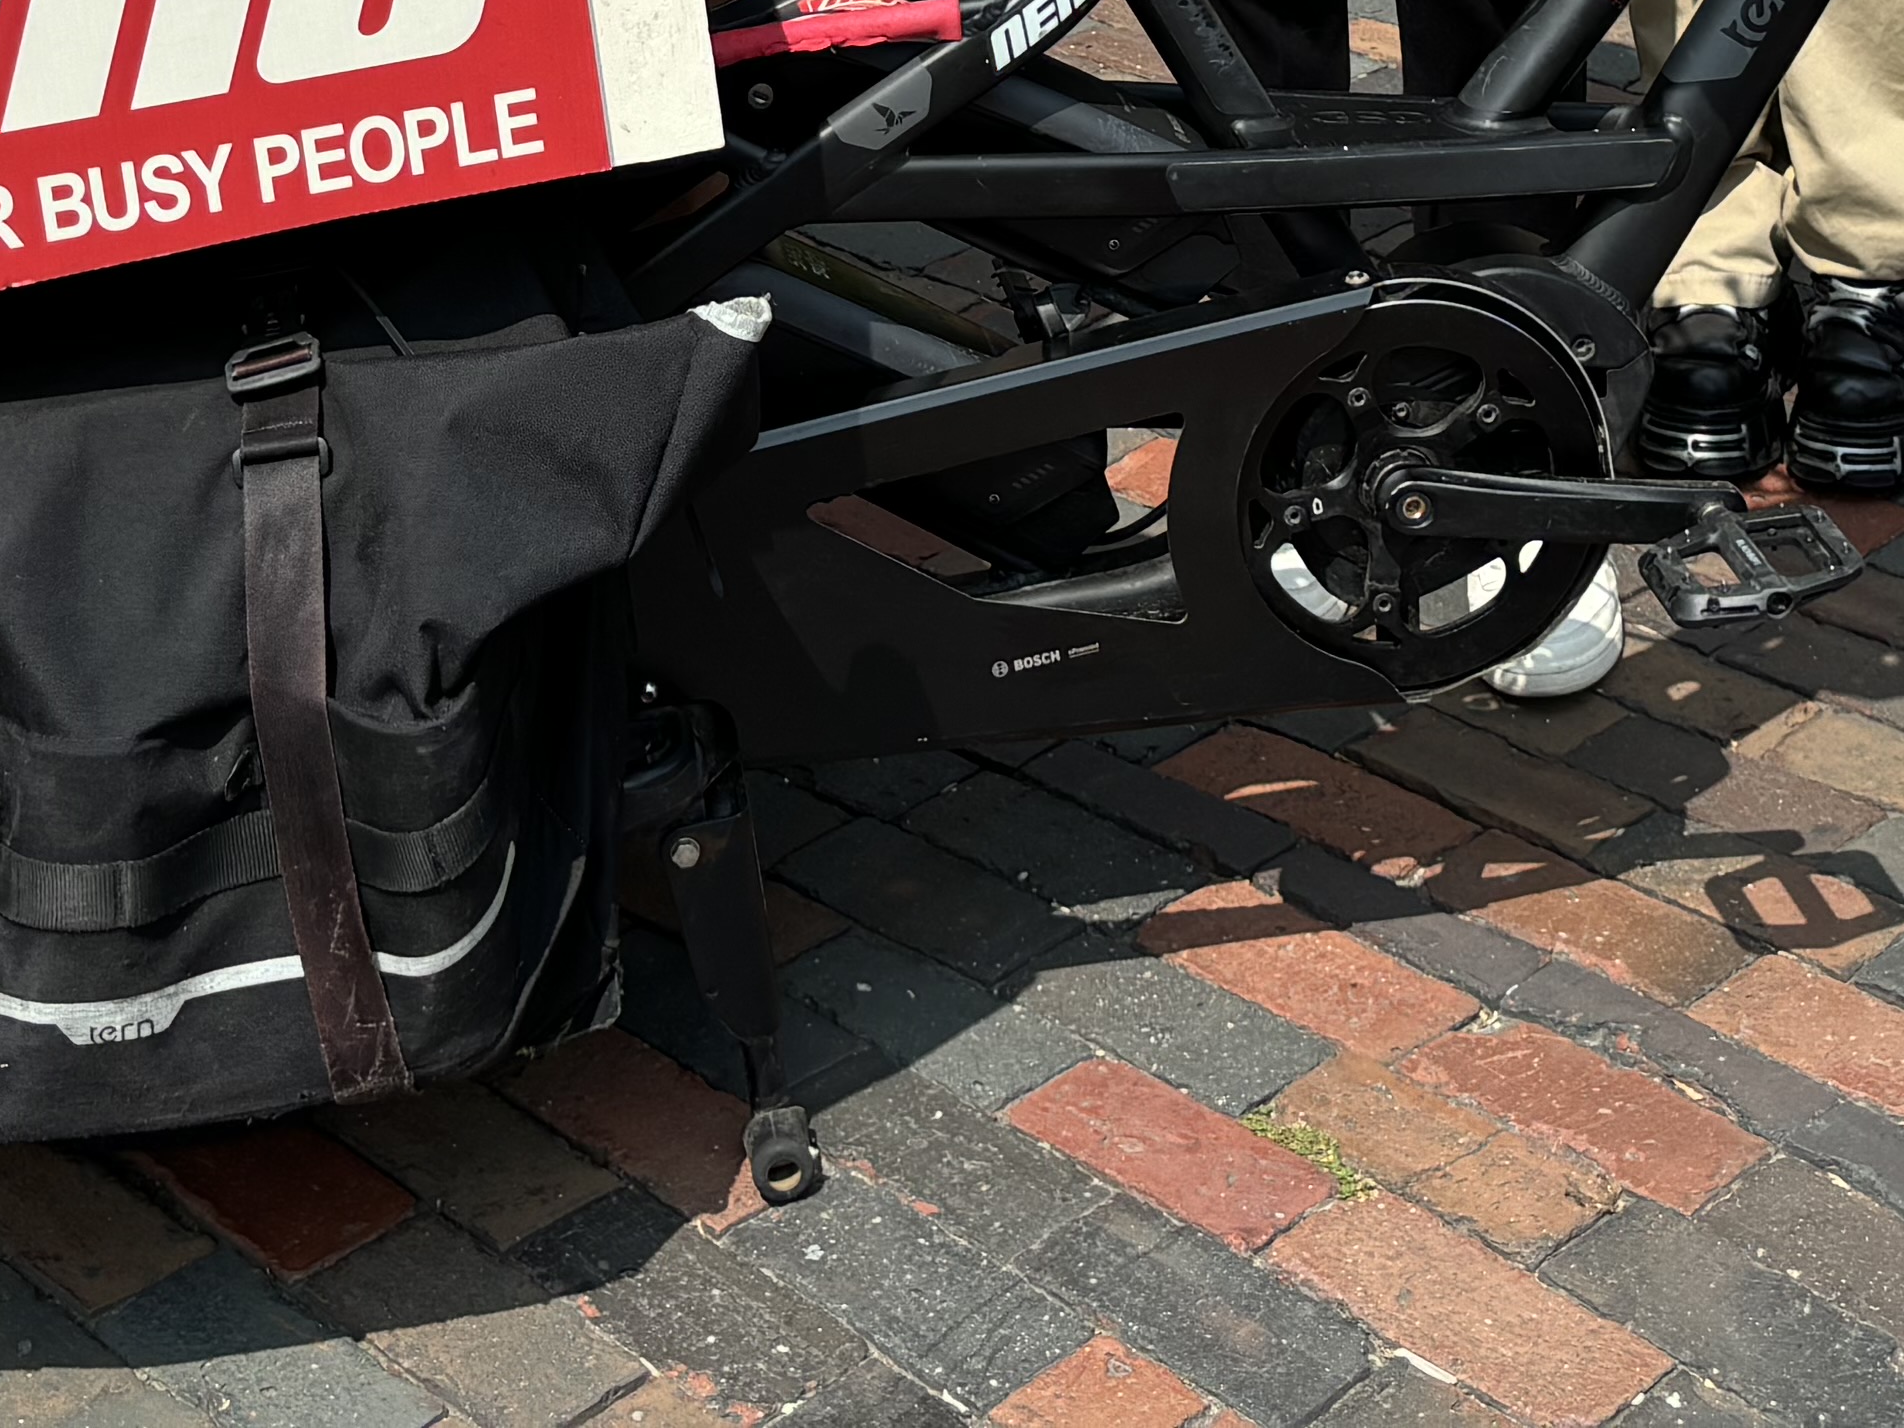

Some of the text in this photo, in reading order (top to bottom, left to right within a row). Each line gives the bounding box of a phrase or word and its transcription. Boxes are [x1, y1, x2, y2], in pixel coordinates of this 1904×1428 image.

[37, 143, 232, 243] BUSY
[253, 88, 545, 203] PEOPLE
[1013, 649, 1061, 672] BOSCH
[89, 1018, 156, 1044] tern
